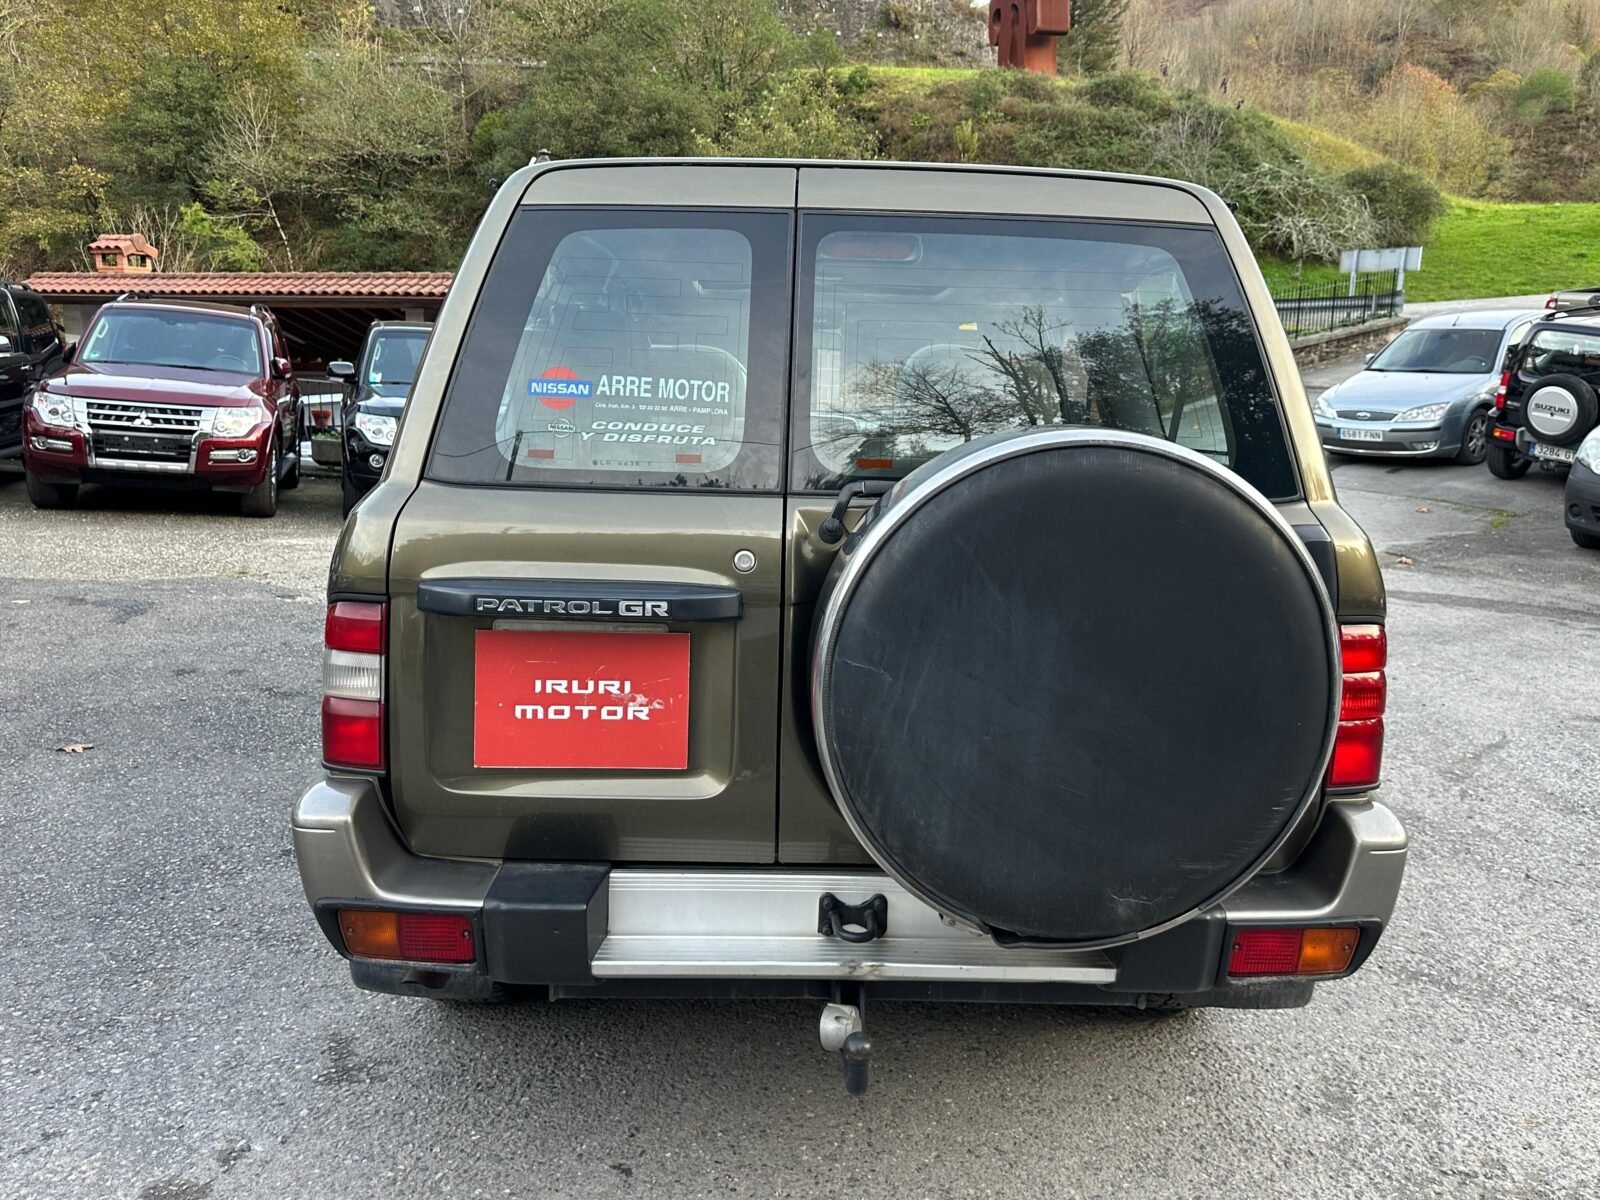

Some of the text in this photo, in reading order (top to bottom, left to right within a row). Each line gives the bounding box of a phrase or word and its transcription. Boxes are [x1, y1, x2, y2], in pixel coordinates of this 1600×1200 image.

[530, 381, 590, 396] NISSAN
[596, 375, 730, 403] ARRE MOTOR
[669, 405, 688, 413] ARRE
[692, 406, 728, 415] PAMPLONA
[1534, 402, 1570, 415] SUZUKI
[549, 424, 574, 433] NISSAN
[591, 420, 706, 434] CONDUCE
[1341, 429, 1361, 439] 6581
[580, 431, 716, 446] Y DISFRUTA
[1537, 444, 1578, 461] 3284 GT
[476, 597, 669, 617] PATROL GR
[534, 679, 631, 694] IRURI
[514, 704, 650, 721] MOTOR
